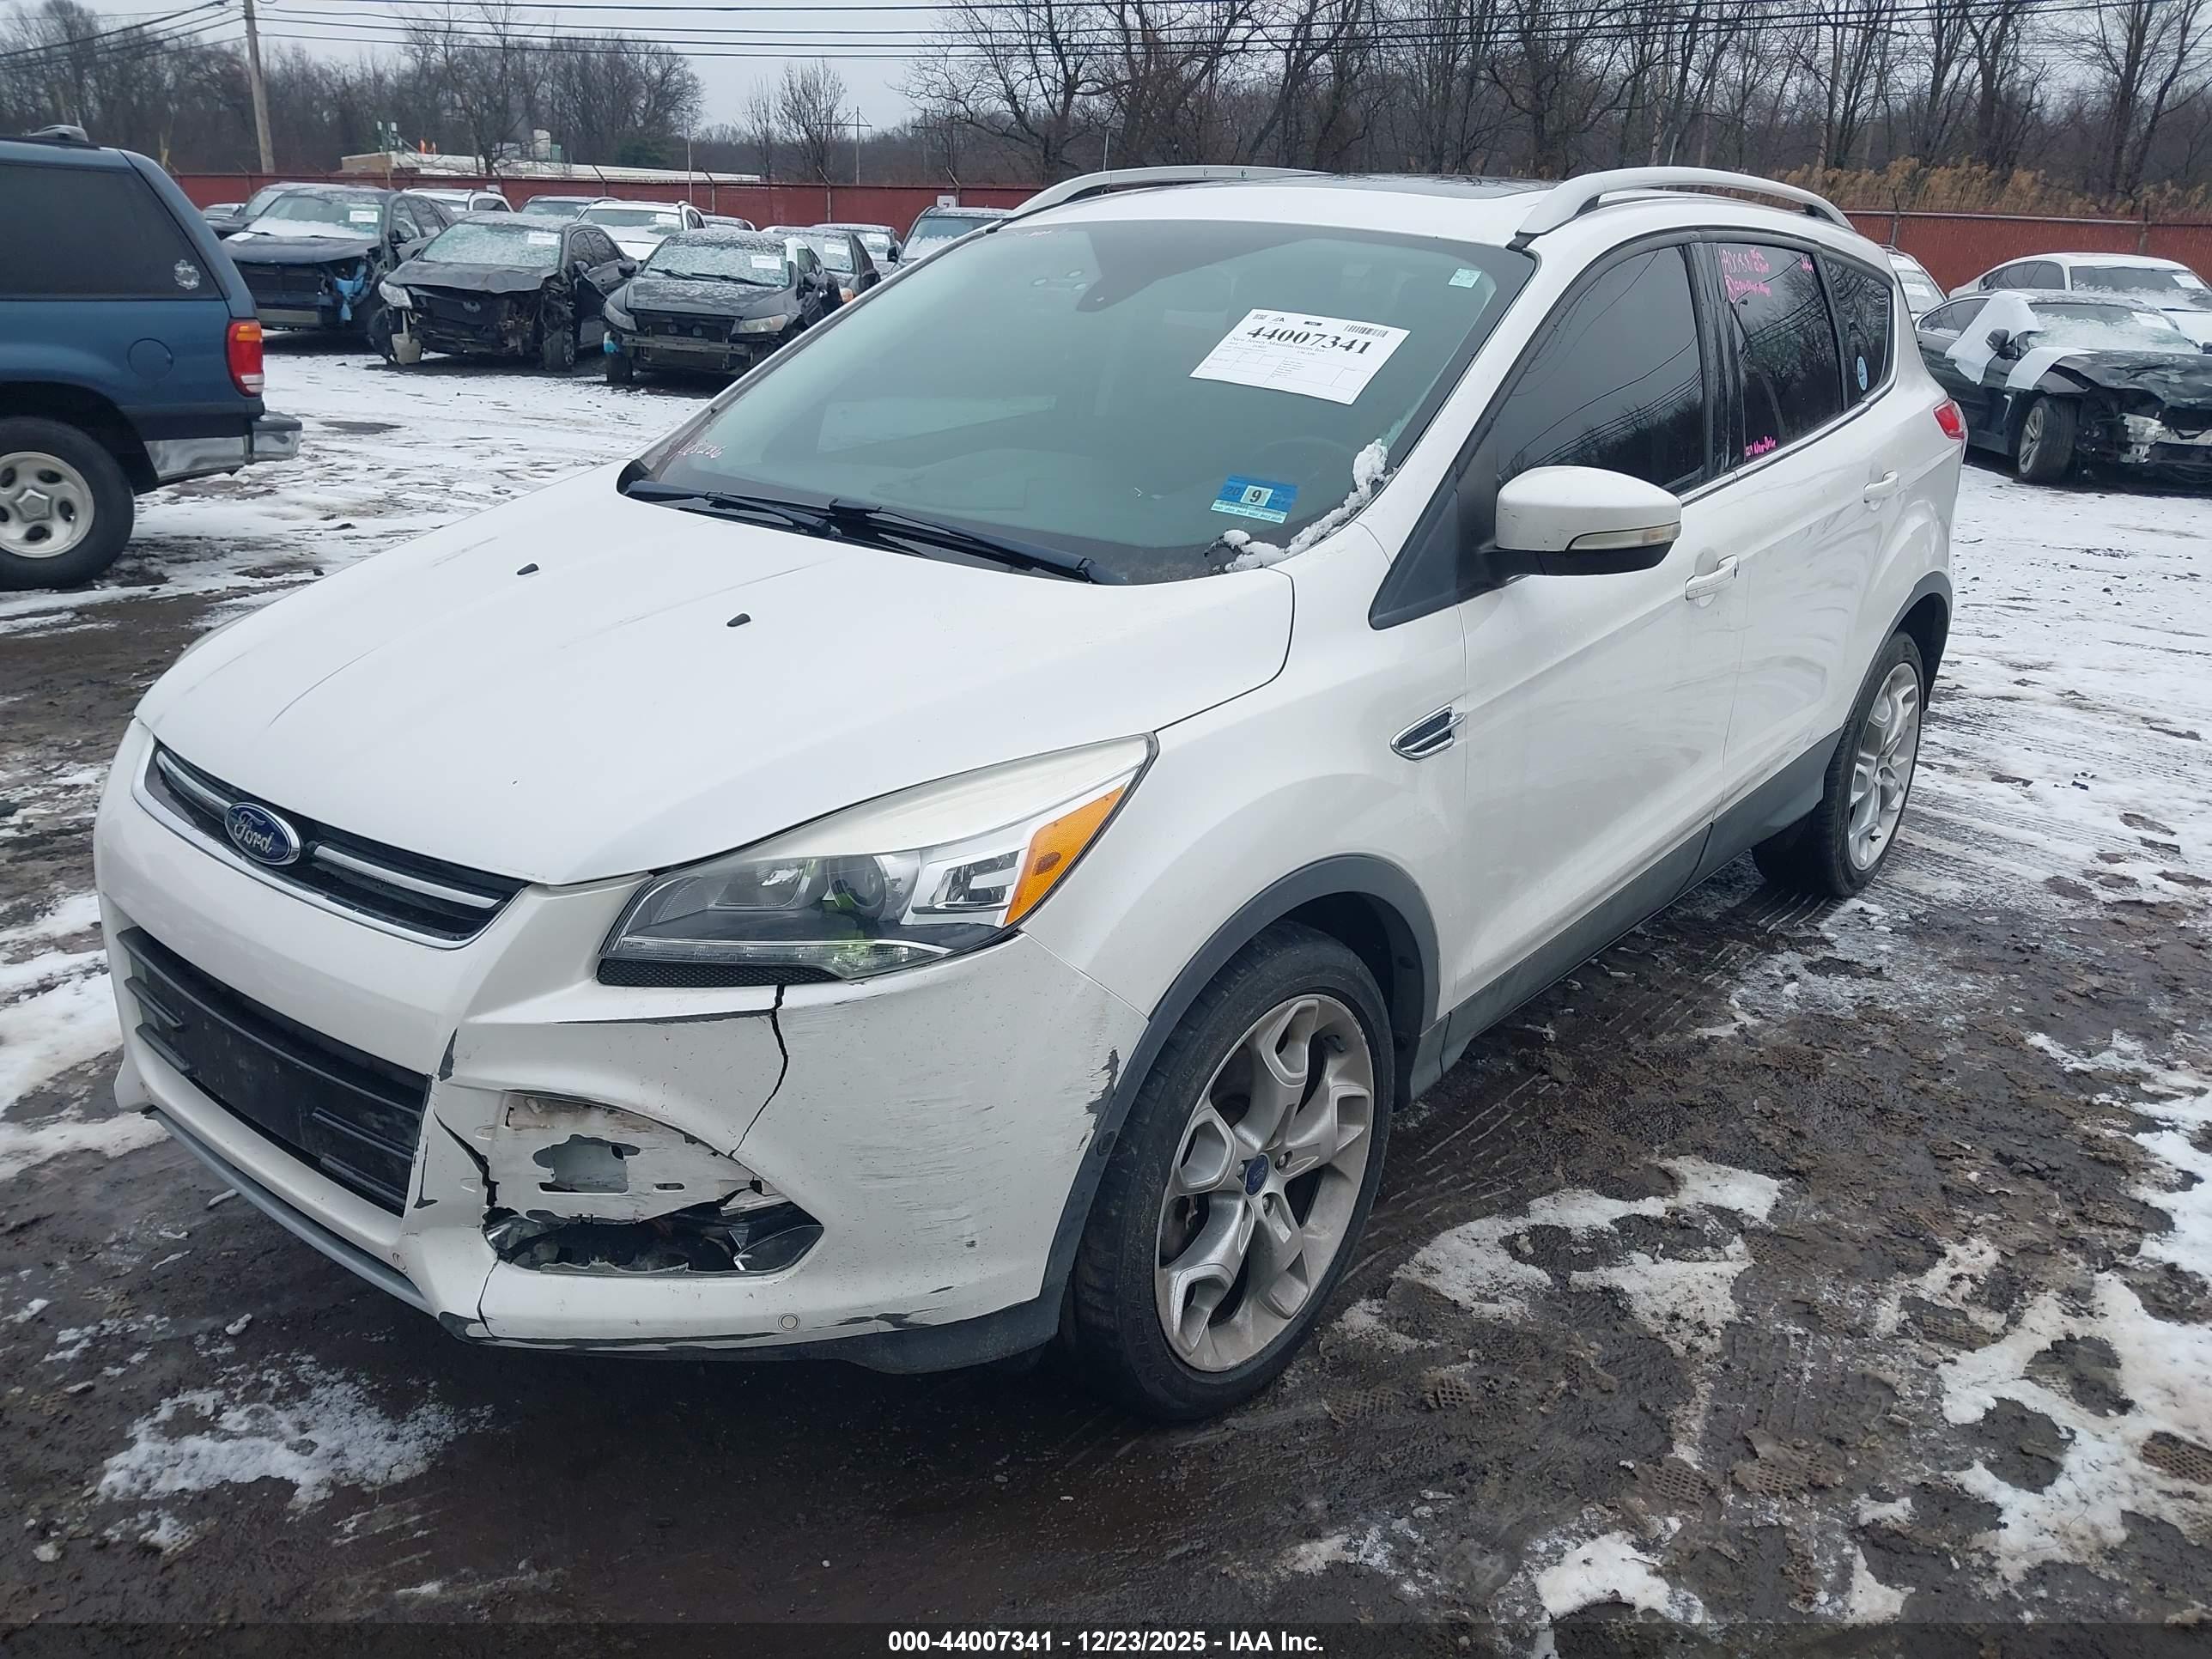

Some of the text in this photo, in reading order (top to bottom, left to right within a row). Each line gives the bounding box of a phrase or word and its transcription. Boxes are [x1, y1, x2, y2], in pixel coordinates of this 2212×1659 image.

[1247, 325, 1372, 355] 44007341
[1249, 489, 1262, 503] 9
[234, 811, 275, 854] Ford
